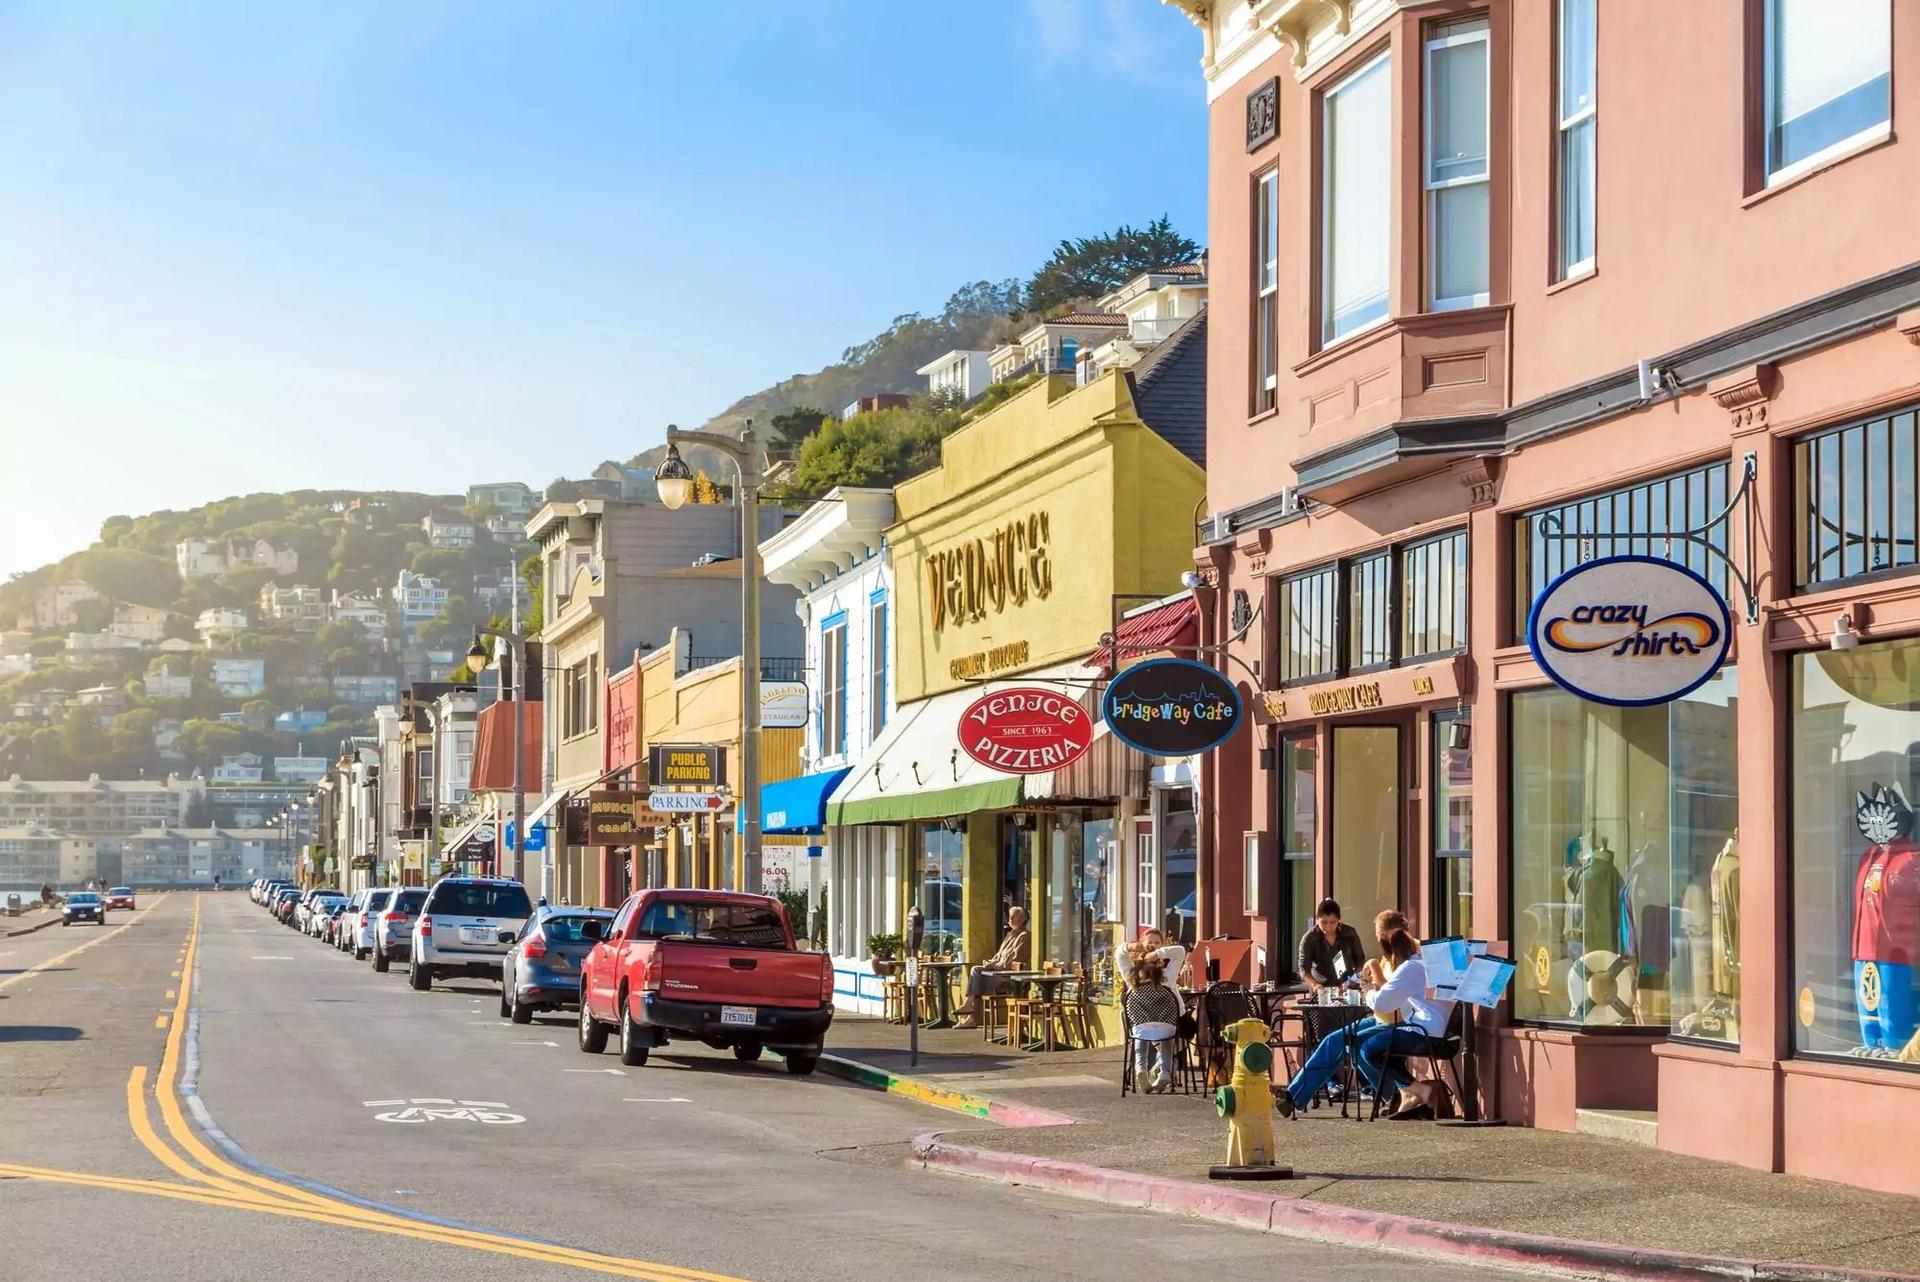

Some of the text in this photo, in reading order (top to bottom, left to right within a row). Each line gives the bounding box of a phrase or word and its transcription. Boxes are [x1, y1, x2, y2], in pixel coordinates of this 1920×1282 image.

[1571, 605, 1648, 629] crazy
[1613, 632, 1701, 656] shirts
[970, 694, 1079, 725] VENICE
[1194, 702, 1233, 720] Cafe
[671, 752, 706, 765] PUBLIC
[974, 737, 1081, 768] PIZZERIA
[666, 766, 710, 779] PARKING
[652, 796, 707, 808] PARKING
